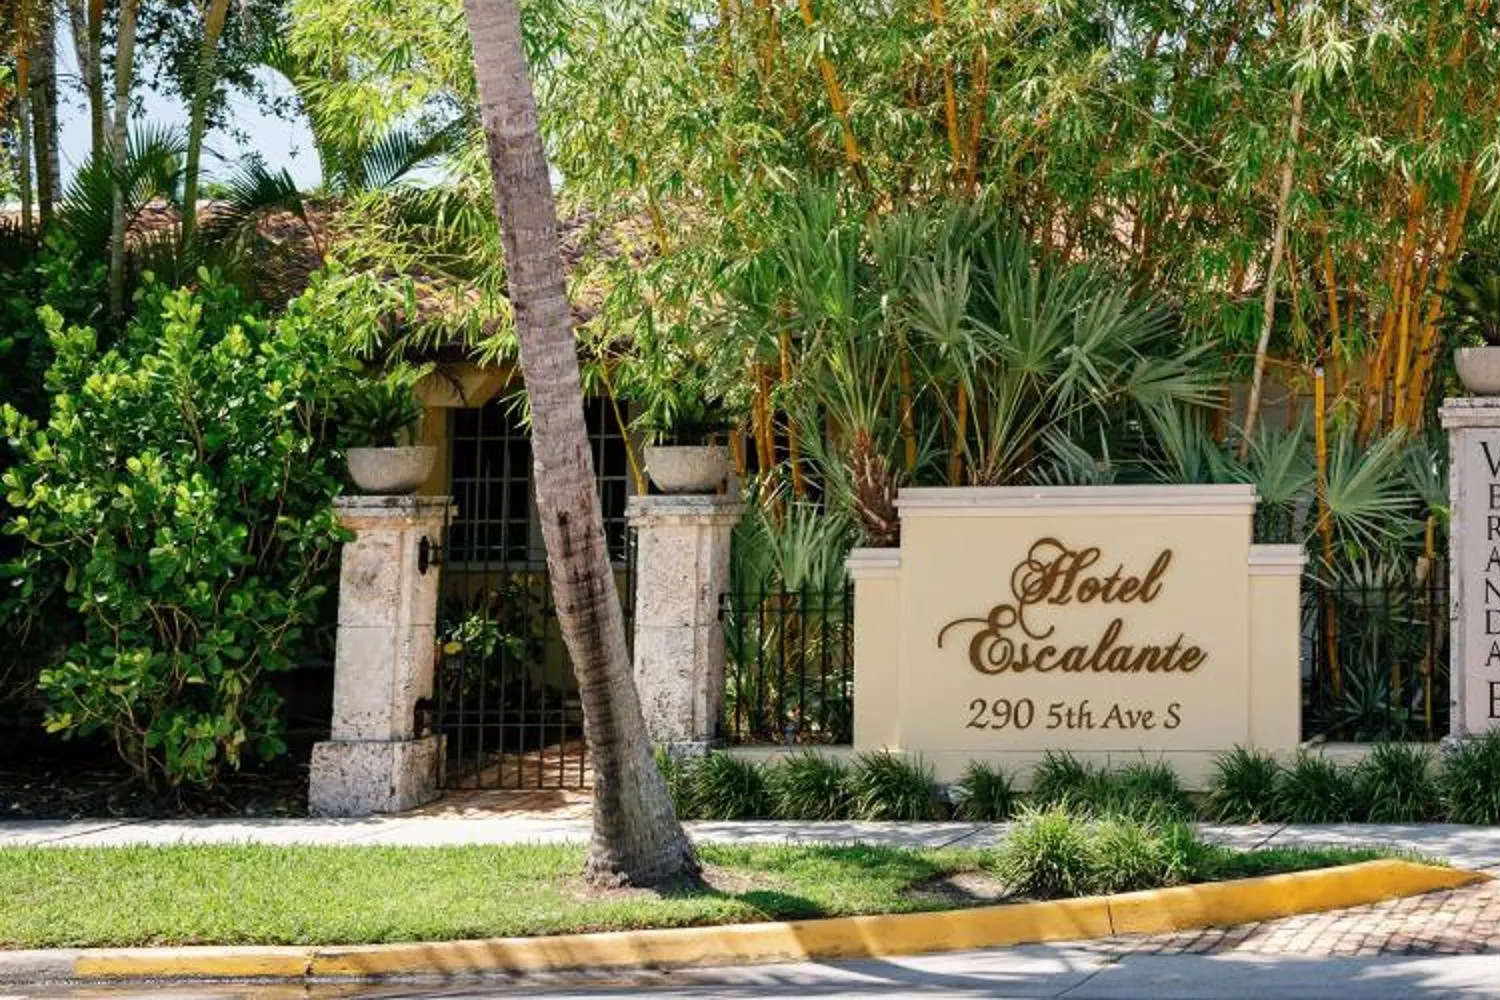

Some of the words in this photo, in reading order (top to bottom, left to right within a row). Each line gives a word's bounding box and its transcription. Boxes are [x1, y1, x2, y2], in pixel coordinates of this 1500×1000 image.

[1011, 537, 1173, 640] Hotel
[938, 603, 1208, 675] Escalante
[965, 698, 1035, 730] 290
[1045, 699, 1092, 730] 5th
[1099, 702, 1157, 730] Ave
[1163, 702, 1182, 730] S
